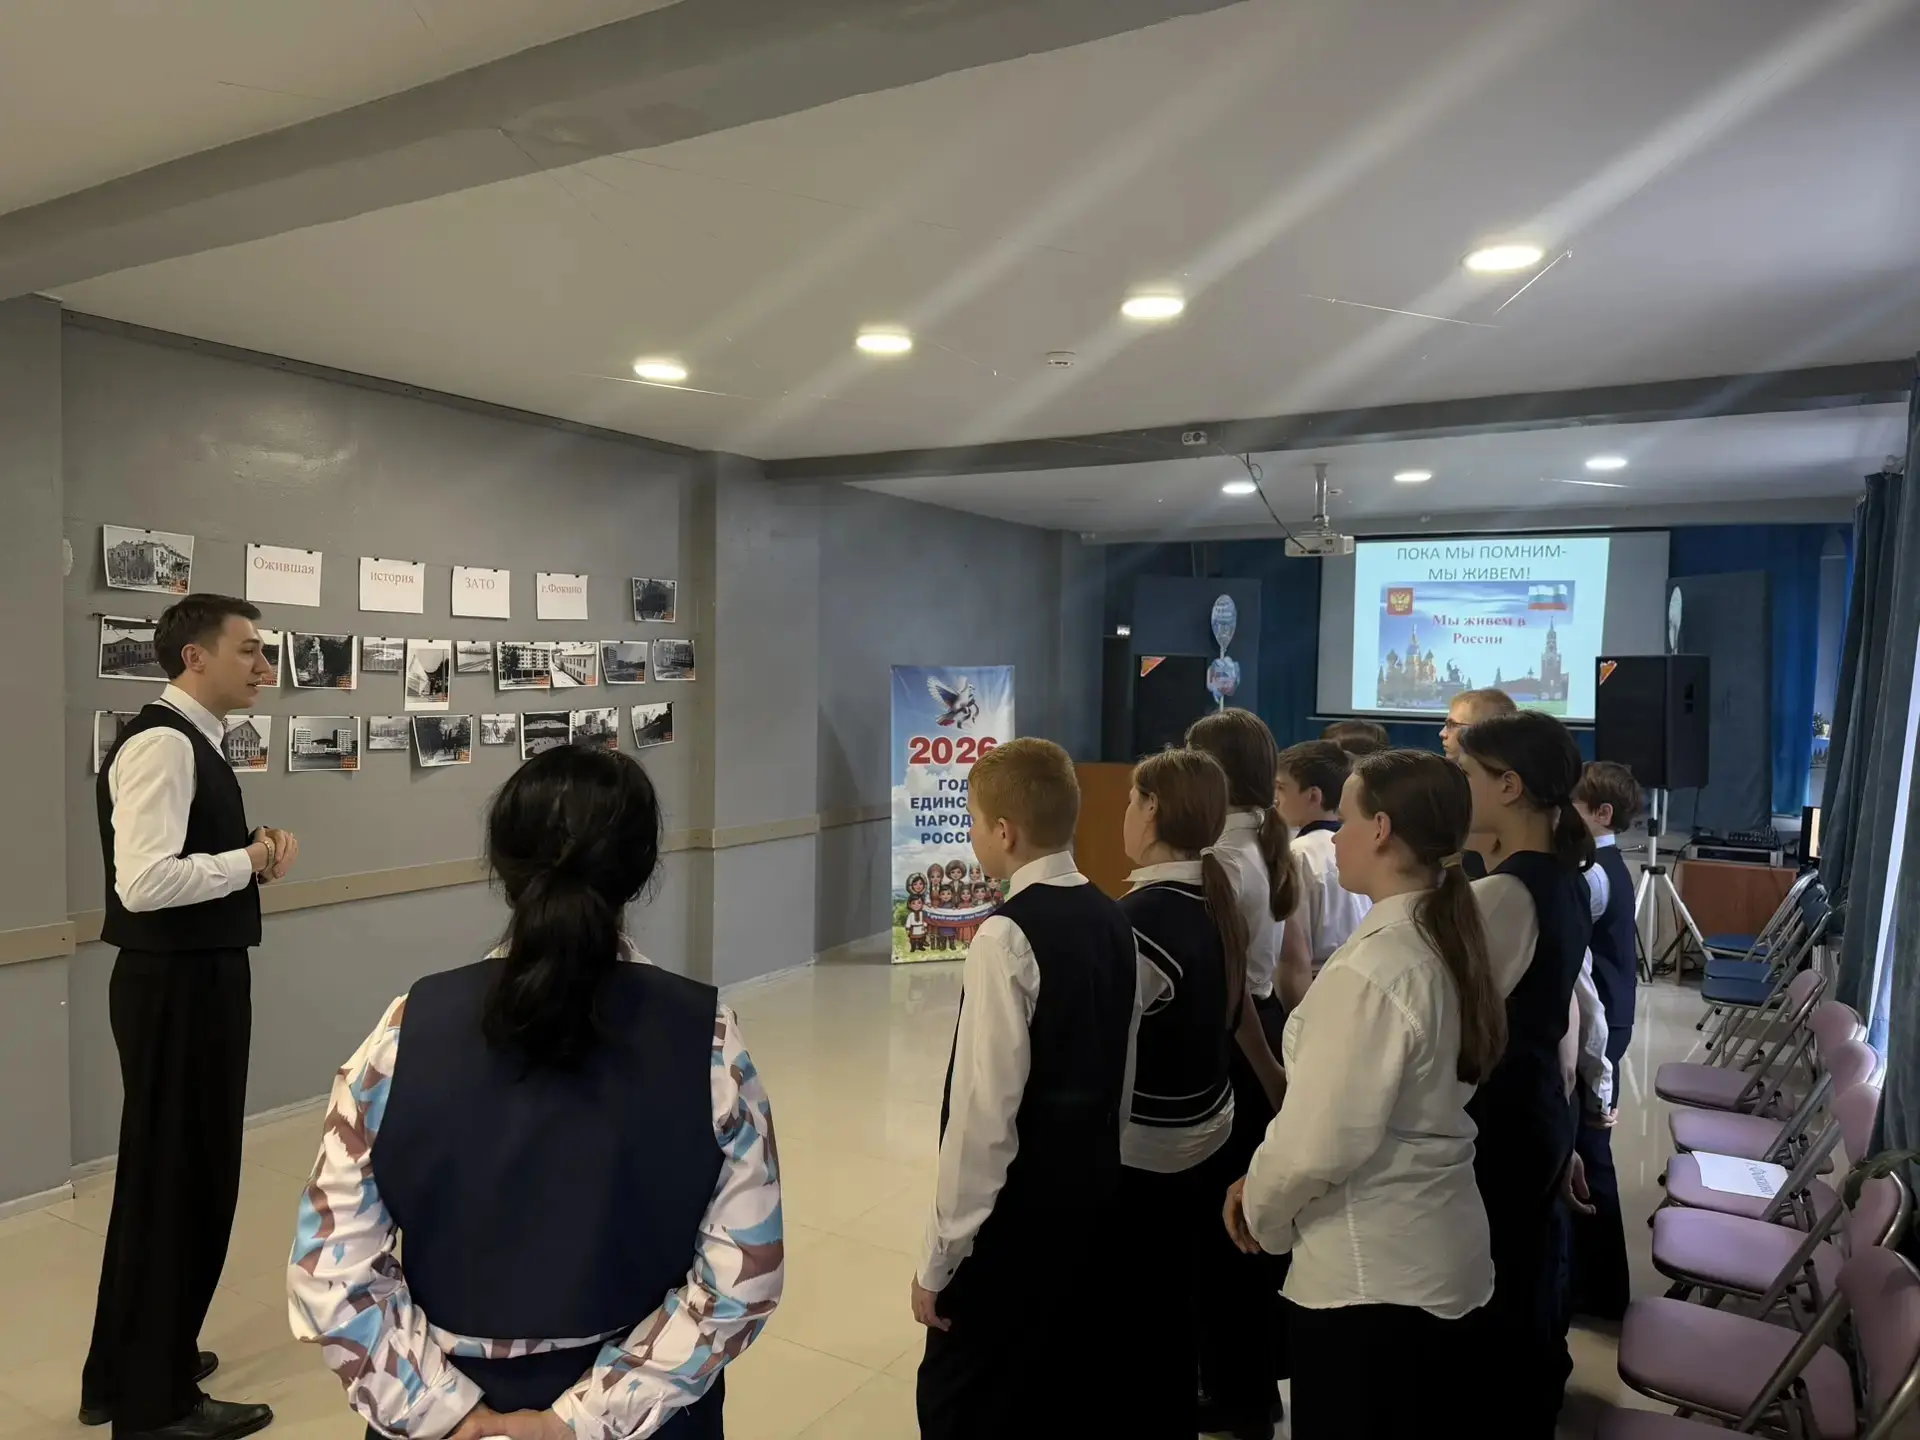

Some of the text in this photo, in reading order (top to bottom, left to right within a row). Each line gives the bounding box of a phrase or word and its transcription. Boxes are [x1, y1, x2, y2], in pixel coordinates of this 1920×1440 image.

[1397, 544, 1567, 560] ПОКА МЫ ПОМНИМ-
[253, 556, 315, 575] Ожившая
[370, 571, 414, 585] история
[1428, 566, 1531, 580] МЫ ЖИВЕМ!
[464, 577, 495, 590] ЗАТО
[1432, 614, 1526, 627] Мы живем в
[1453, 632, 1503, 645] России
[938, 779, 969, 792] ГОД
[910, 796, 967, 811] ЕДИНС
[915, 814, 973, 828] НАРОД
[921, 832, 971, 845] РОСС
